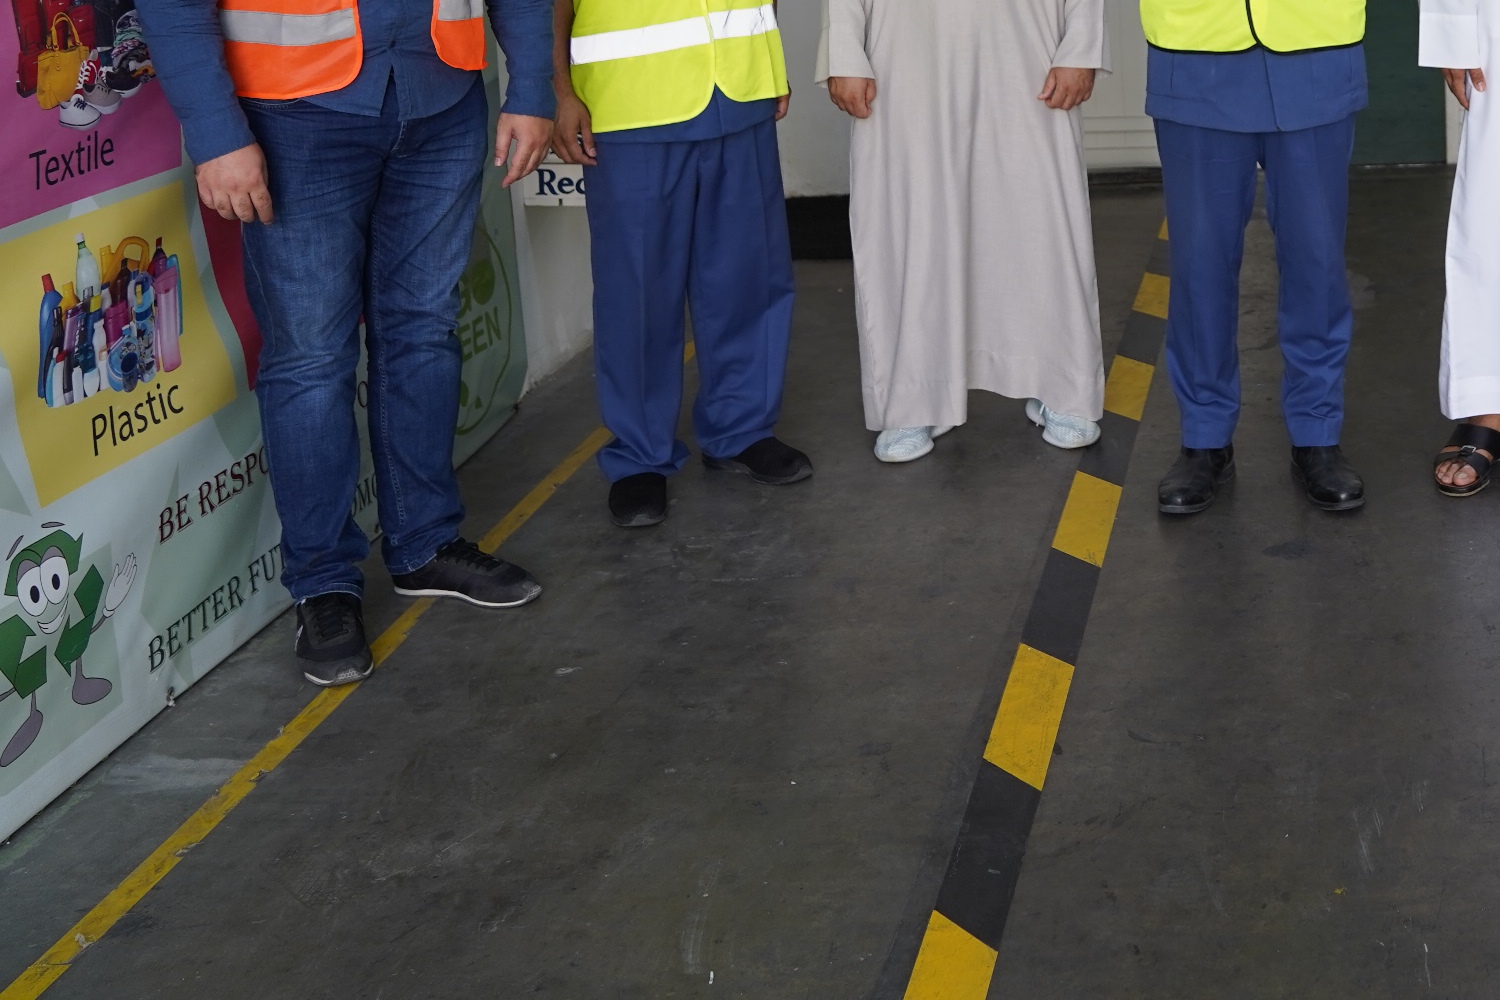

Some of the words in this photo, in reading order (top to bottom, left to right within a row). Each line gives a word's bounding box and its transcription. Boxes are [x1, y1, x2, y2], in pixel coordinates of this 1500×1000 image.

[29, 131, 115, 191] Textile
[90, 383, 184, 457] Plastic
[159, 494, 193, 544] BE
[148, 575, 246, 674] BETTER
